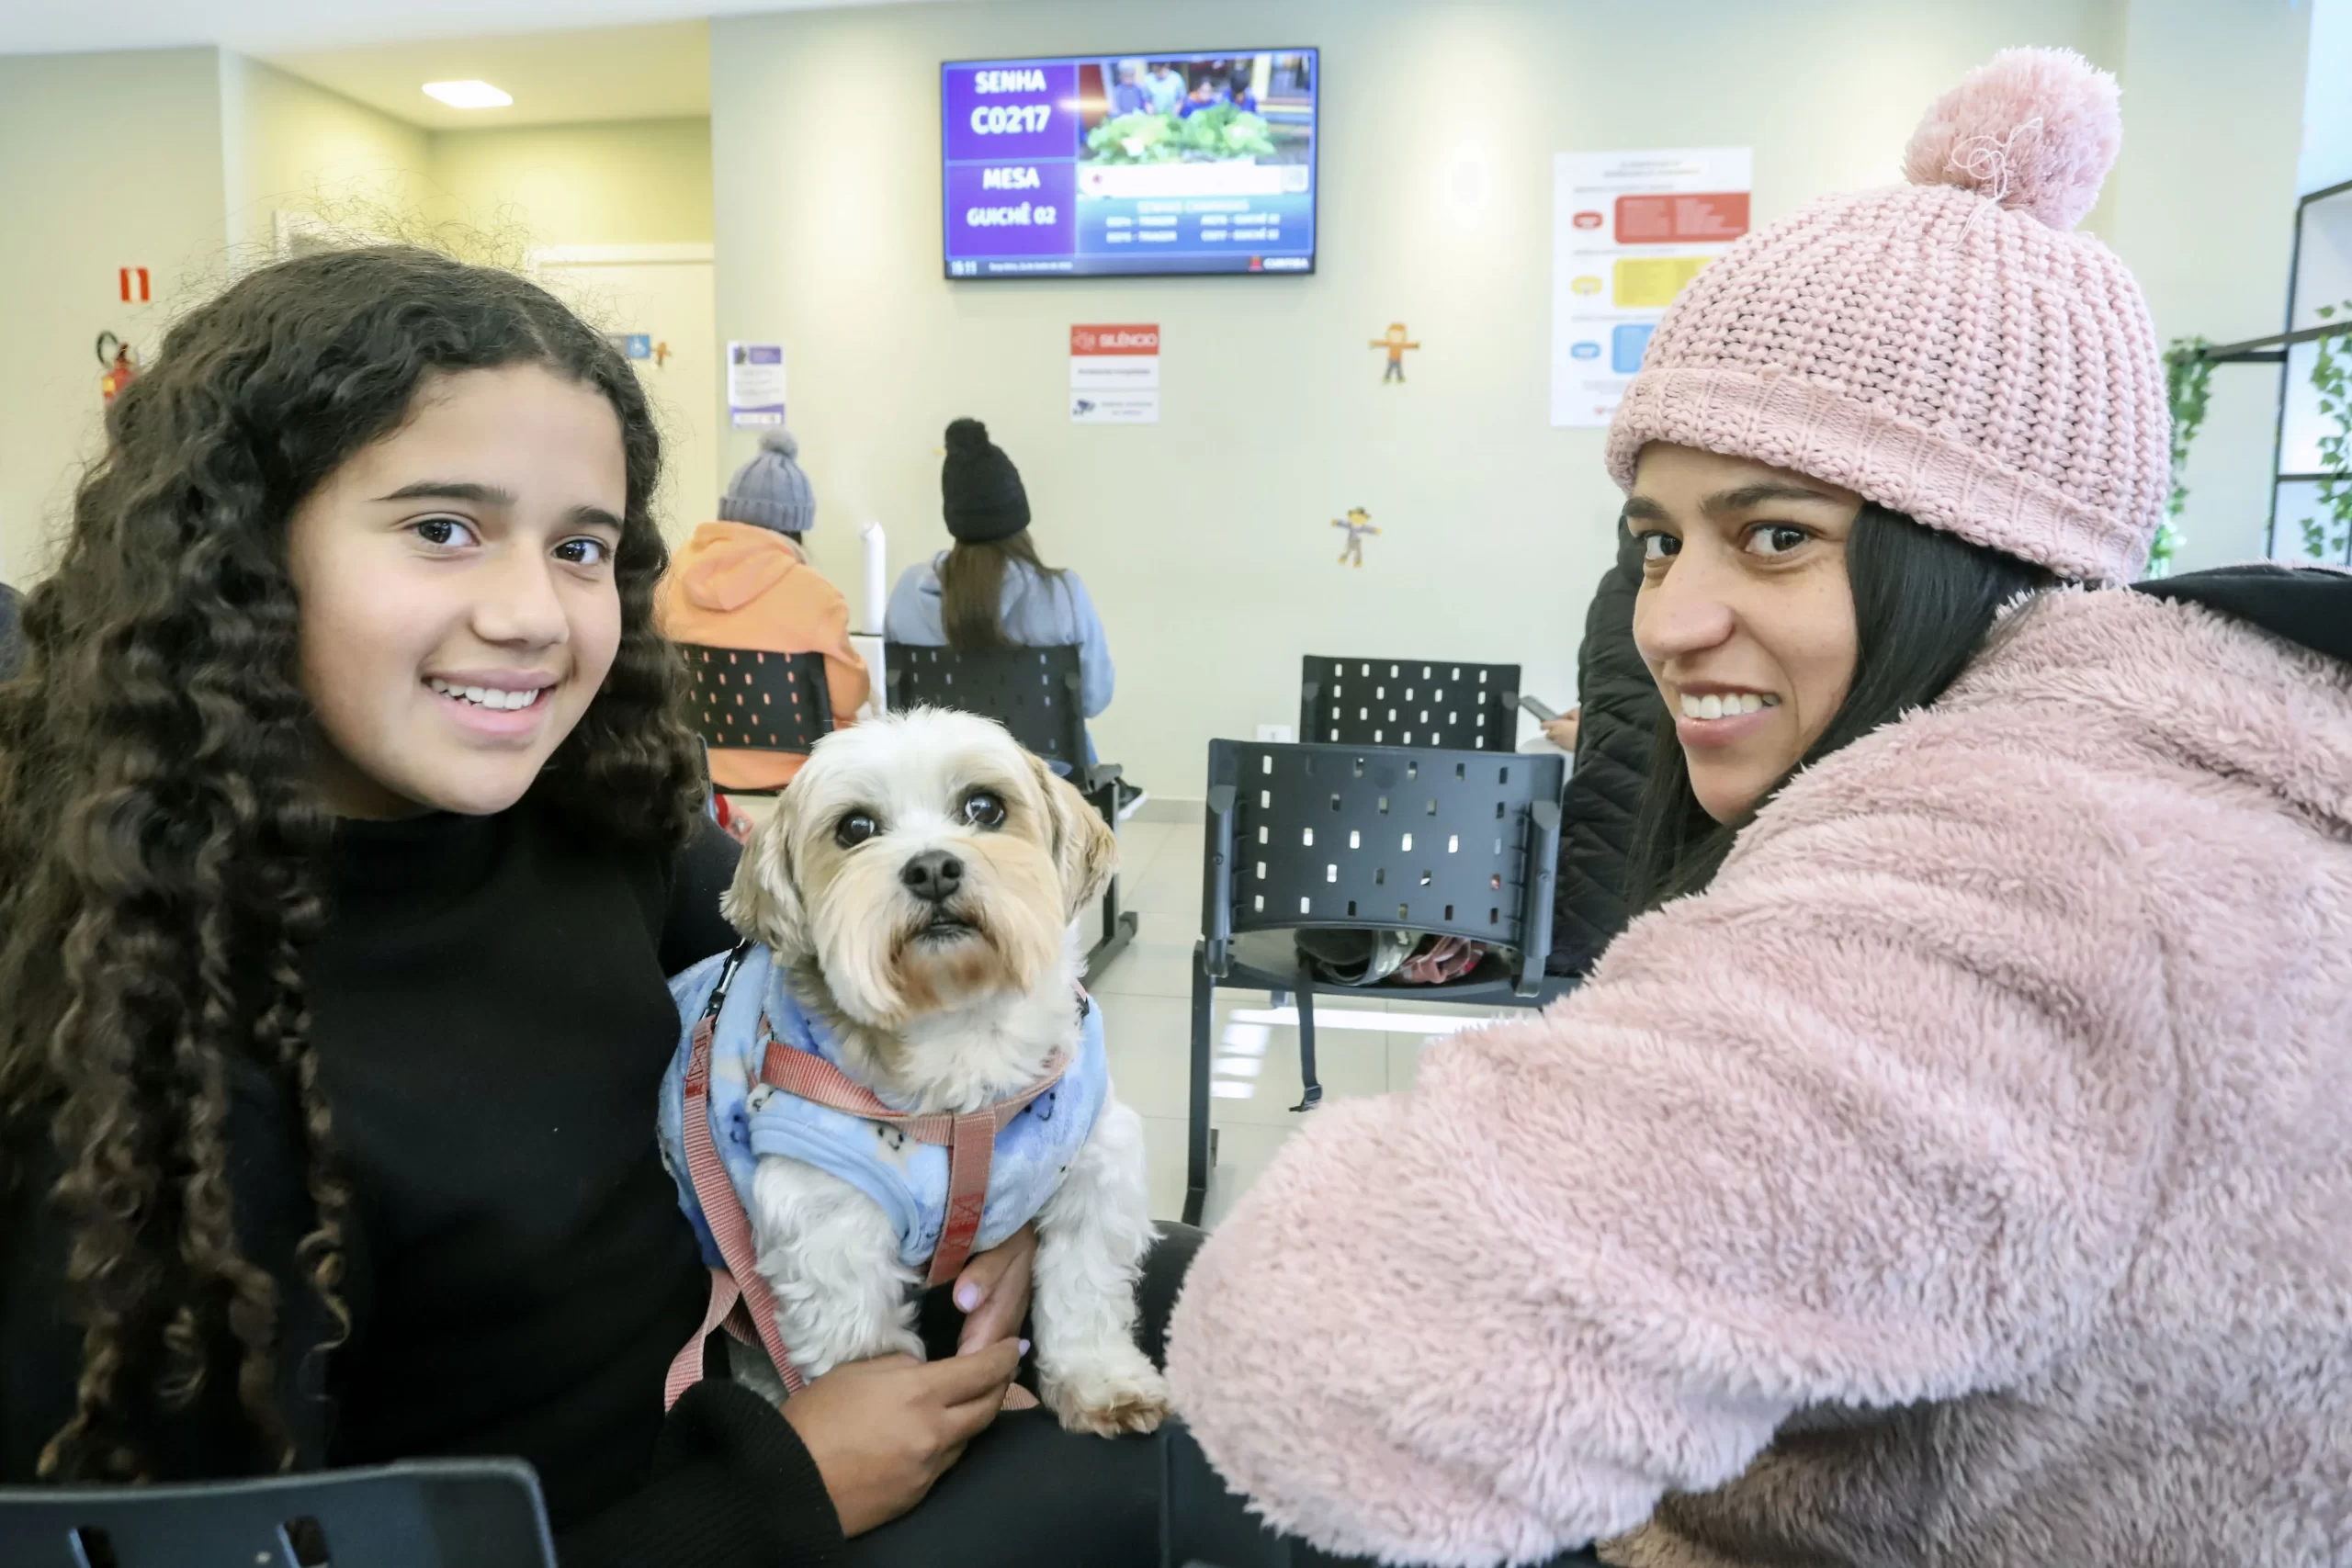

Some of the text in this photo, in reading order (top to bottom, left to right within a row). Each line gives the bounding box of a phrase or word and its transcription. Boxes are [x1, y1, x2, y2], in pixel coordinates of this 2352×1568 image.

[975, 69, 1046, 94] SENHA
[970, 105, 1051, 134] C0217
[983, 167, 1041, 190] MESA
[1034, 206, 1057, 225] 02
